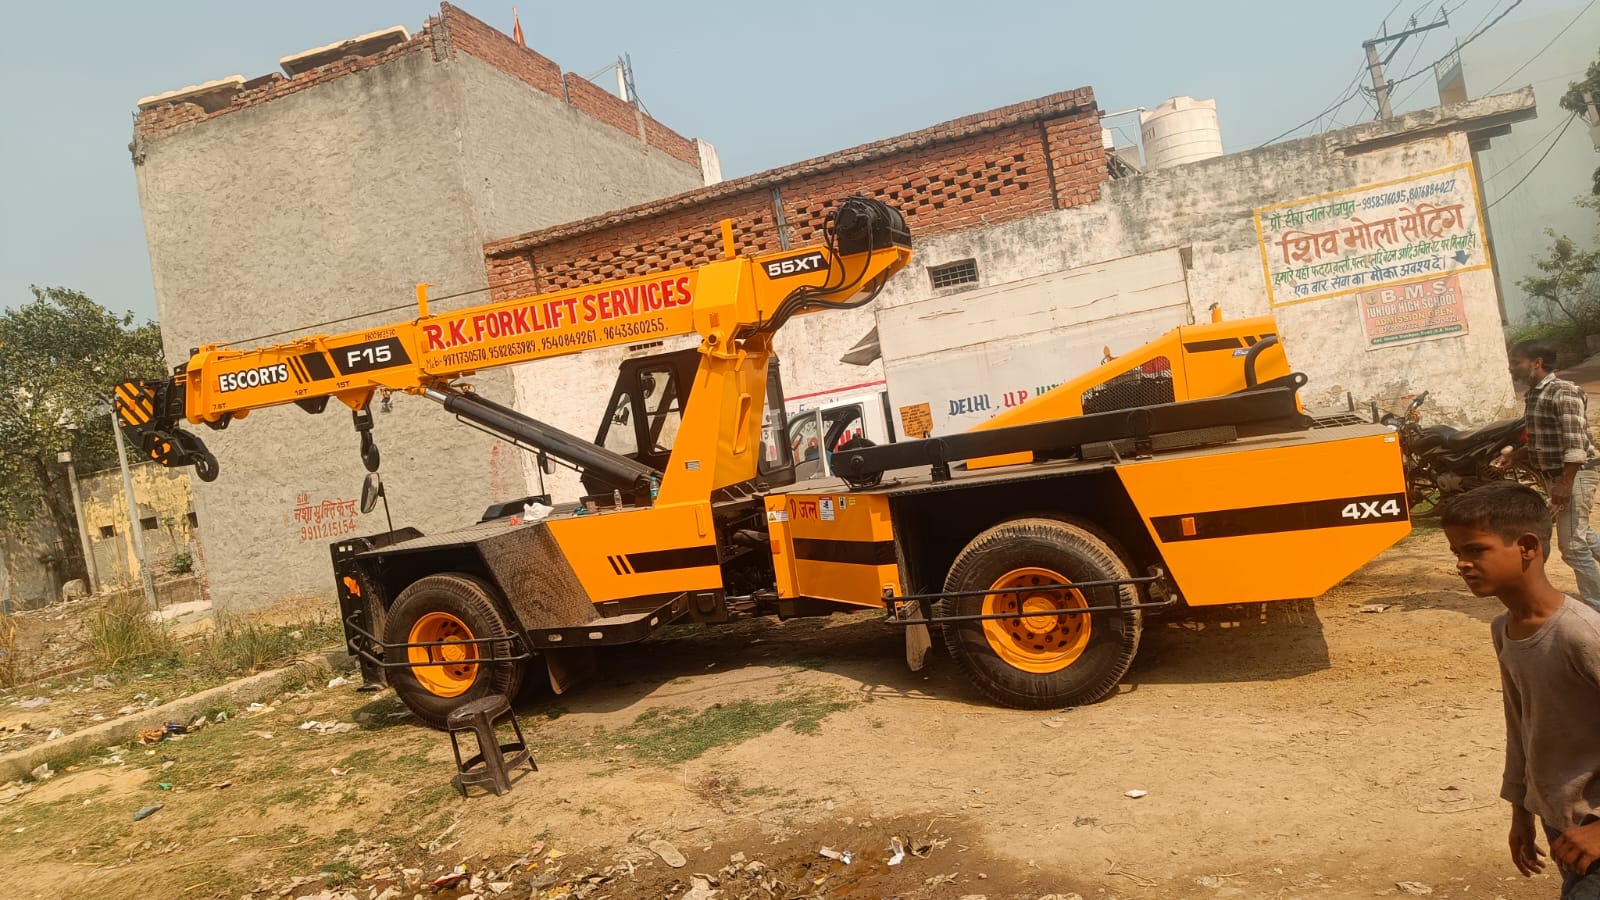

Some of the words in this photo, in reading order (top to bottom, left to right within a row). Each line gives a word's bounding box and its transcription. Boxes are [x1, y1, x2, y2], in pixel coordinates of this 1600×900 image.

[1305, 206, 1327, 223] लाल
[1275, 228, 1340, 265] शिव
[1340, 216, 1399, 249] भोला
[768, 254, 822, 277] 55XT
[1271, 267, 1294, 285] हमारे
[1294, 284, 1309, 297] एक
[1311, 280, 1329, 293] बार
[1331, 275, 1351, 290] सेवा
[1351, 272, 1368, 285] का
[1369, 265, 1399, 282] मौका
[1399, 258, 1432, 277] अवश्य
[583, 277, 692, 322] SERVICES
[1381, 280, 1455, 304] B.M.S.
[1375, 312, 1425, 326] ADMISSION
[347, 345, 392, 368] F15
[219, 363, 289, 393] ESCORTS
[293, 506, 313, 524] नशा
[314, 499, 338, 524] मुक्ति
[1341, 499, 1400, 520] 4X4
[301, 518, 357, 541] 9911215154
